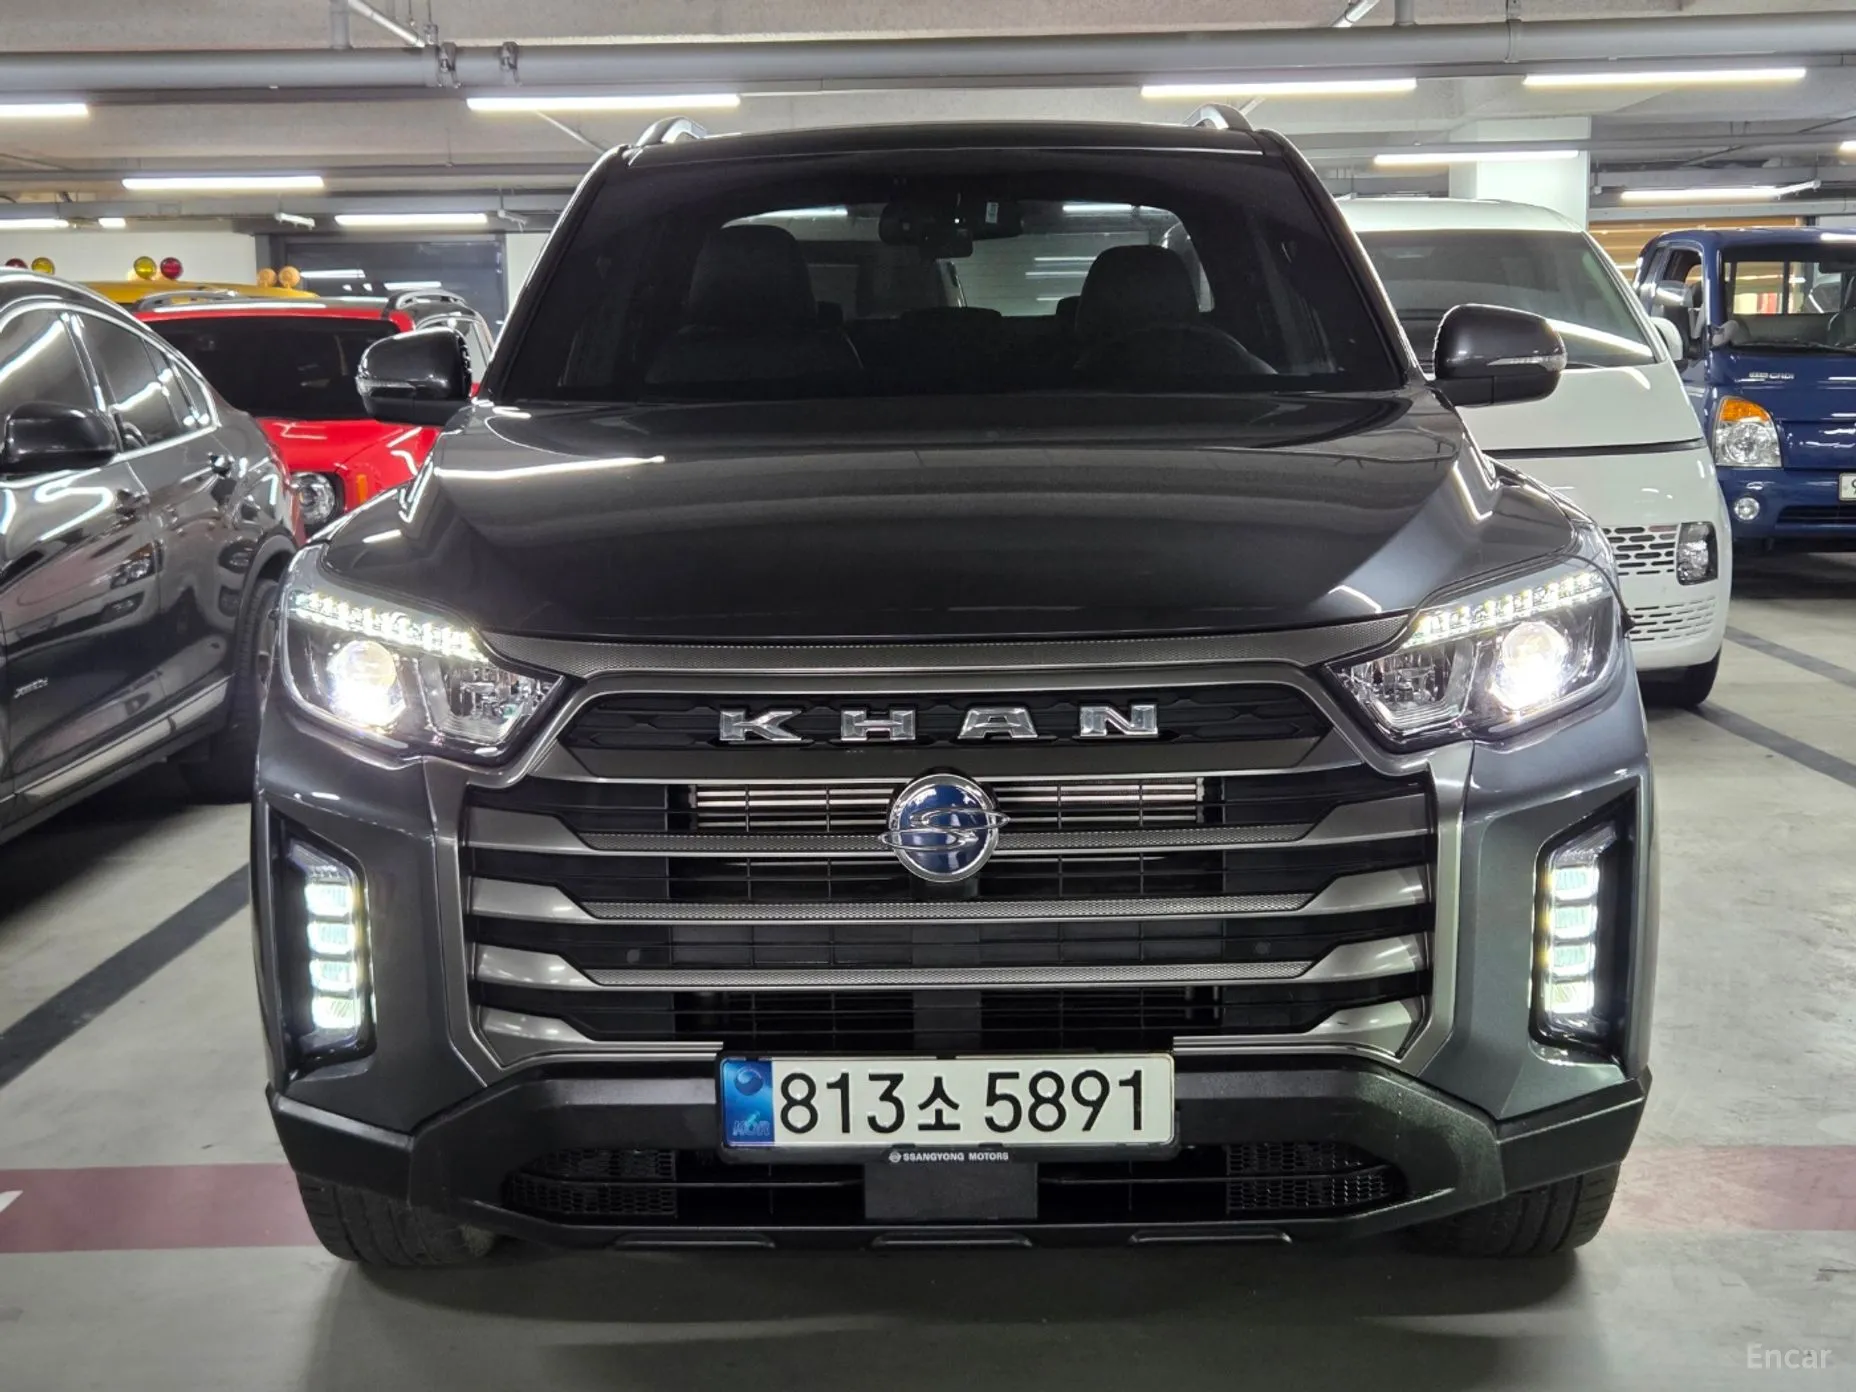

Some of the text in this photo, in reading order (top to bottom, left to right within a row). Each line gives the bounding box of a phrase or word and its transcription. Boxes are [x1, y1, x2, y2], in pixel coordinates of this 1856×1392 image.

[719, 703, 1159, 741] KHAN
[780, 1069, 1143, 1134] 813소 5891
[903, 1151, 1009, 1162] SSANGYONG MOTORS
